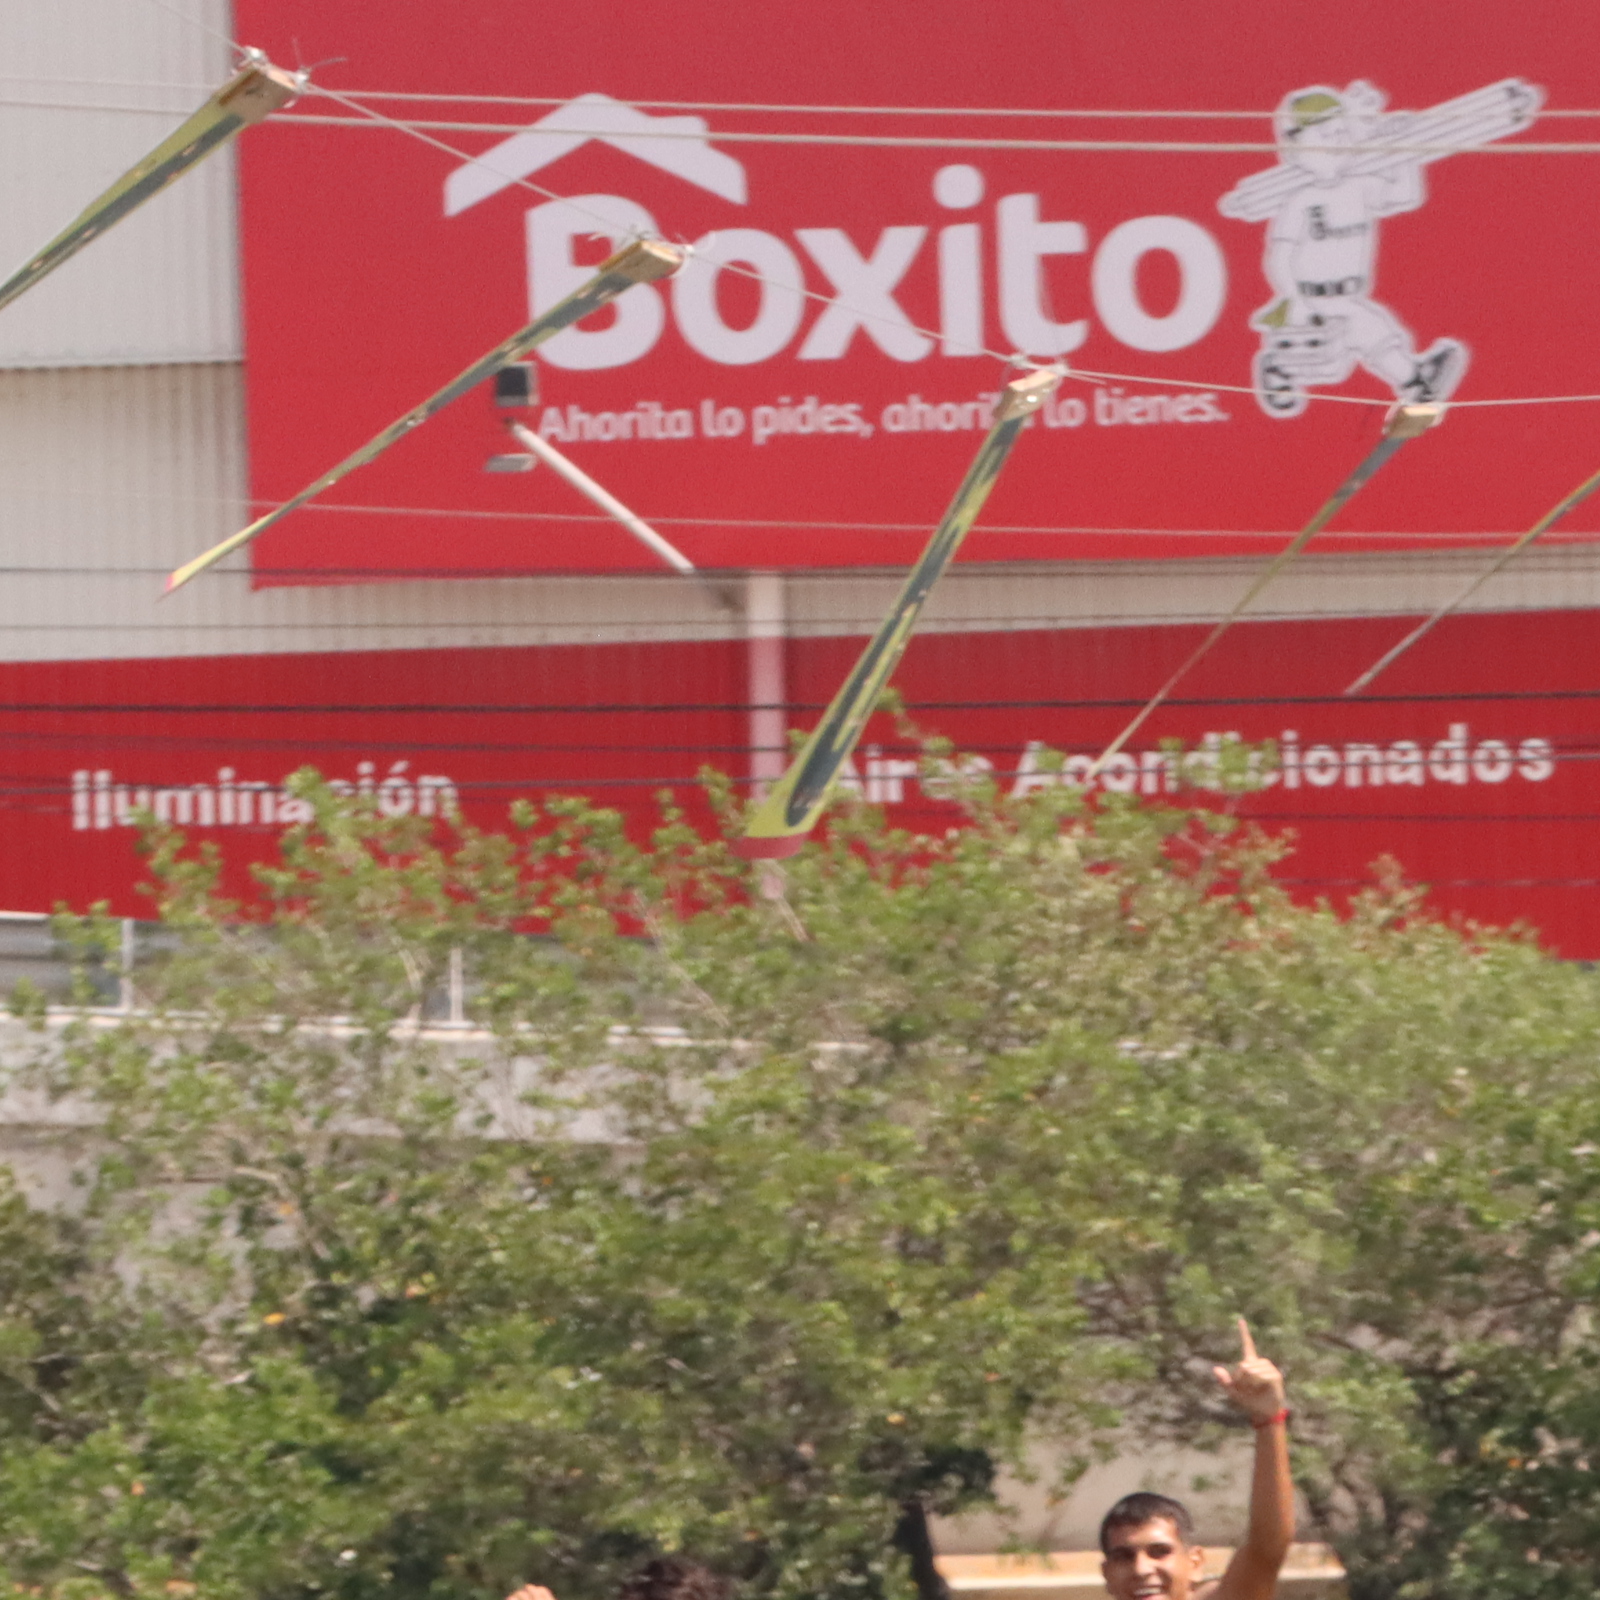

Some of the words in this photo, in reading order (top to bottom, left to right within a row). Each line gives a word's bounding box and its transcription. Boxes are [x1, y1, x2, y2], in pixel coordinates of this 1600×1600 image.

[525, 163, 1229, 372] Boxito
[537, 399, 694, 443] Ahorita
[701, 399, 746, 438] lo
[752, 395, 876, 446] pides,
[881, 388, 1035, 433] ahori
[1043, 388, 1088, 429] lo
[1094, 386, 1231, 427] tienes.
[1010, 722, 1556, 800] Acondcionados
